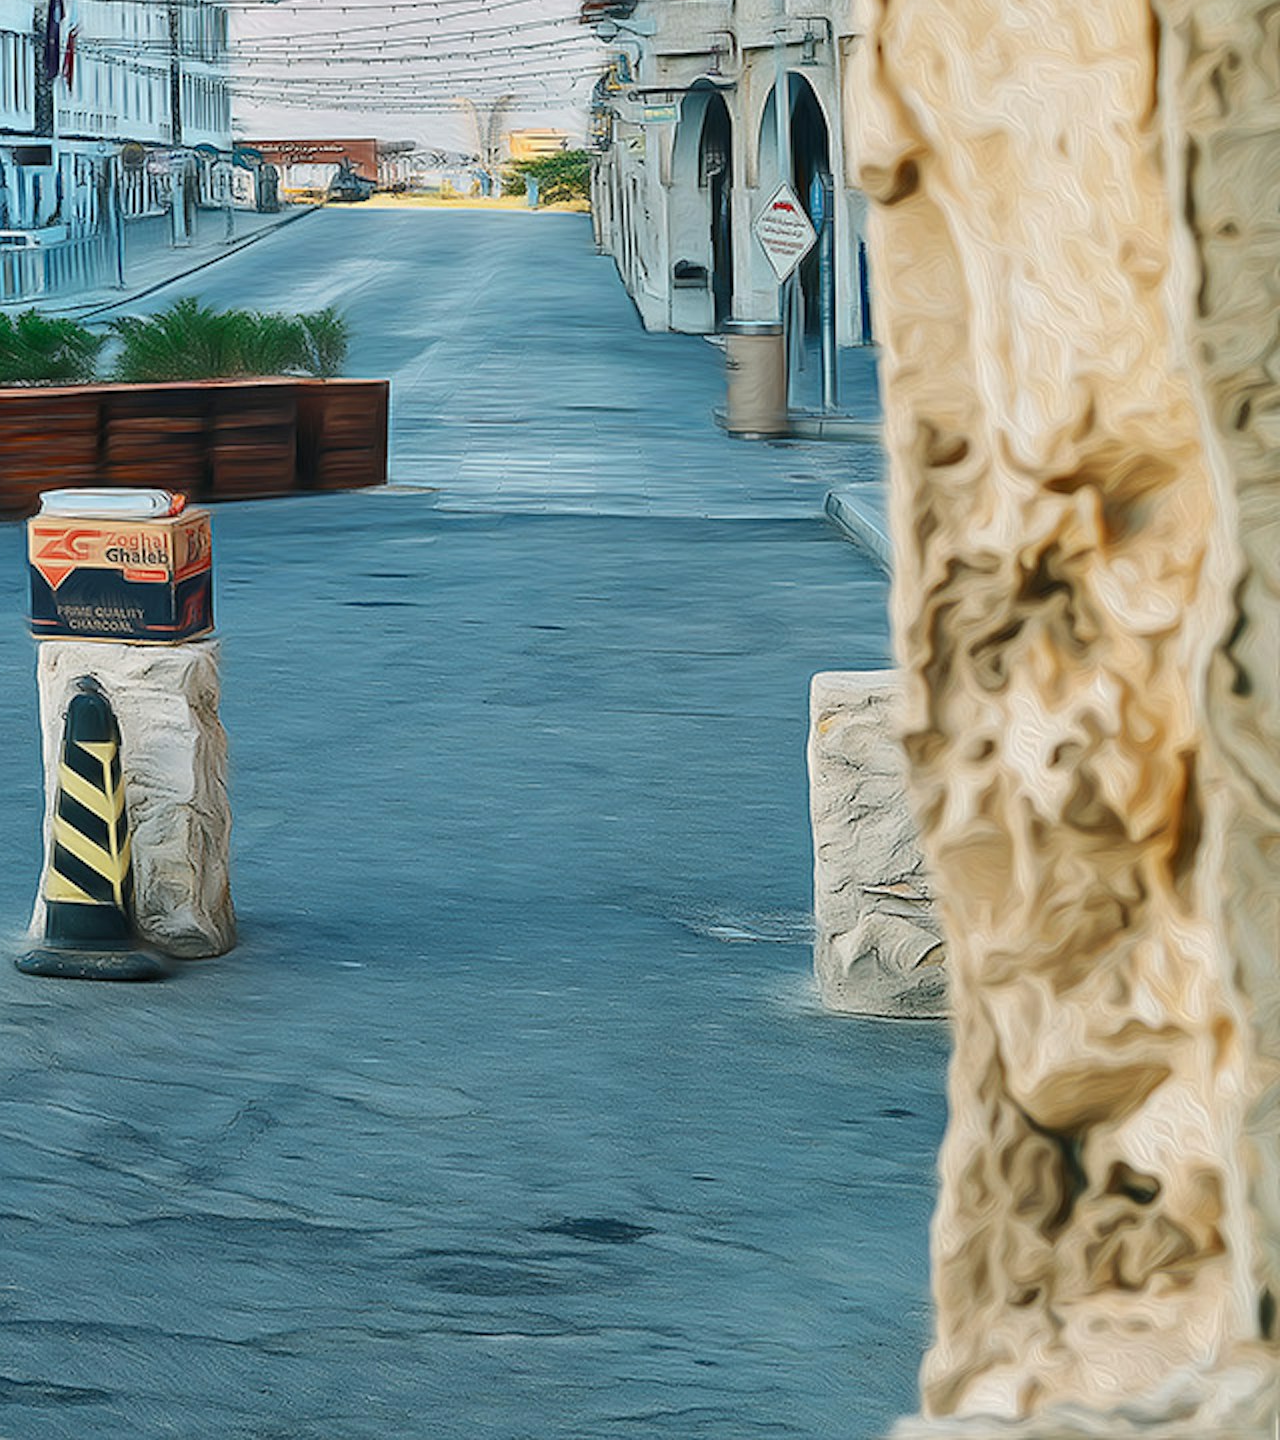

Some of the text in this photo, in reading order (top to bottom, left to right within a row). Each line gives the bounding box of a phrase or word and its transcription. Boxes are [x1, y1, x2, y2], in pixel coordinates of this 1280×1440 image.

[105, 531, 168, 551] Zoghal
[105, 548, 170, 565] Ghaleb
[56, 604, 145, 619] PRIME QUALITY
[68, 619, 135, 633] CHARCOAL
